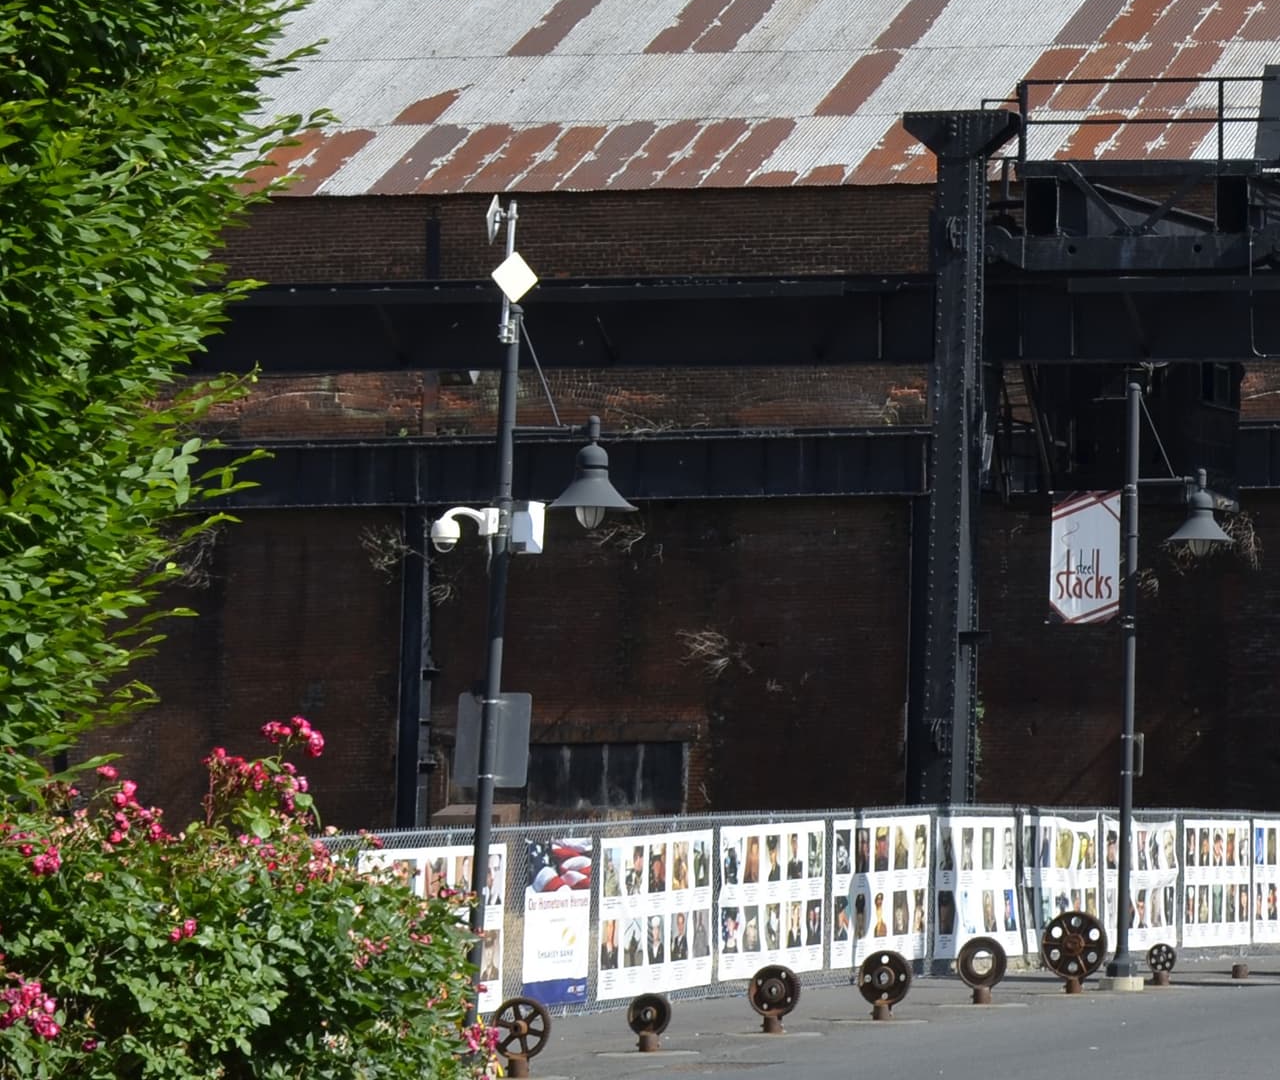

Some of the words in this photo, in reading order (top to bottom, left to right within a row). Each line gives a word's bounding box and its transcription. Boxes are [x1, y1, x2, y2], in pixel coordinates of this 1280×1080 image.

[1056, 547, 1113, 600] stacks
[1075, 547, 1096, 576] steel
[538, 896, 569, 911] Hometown
